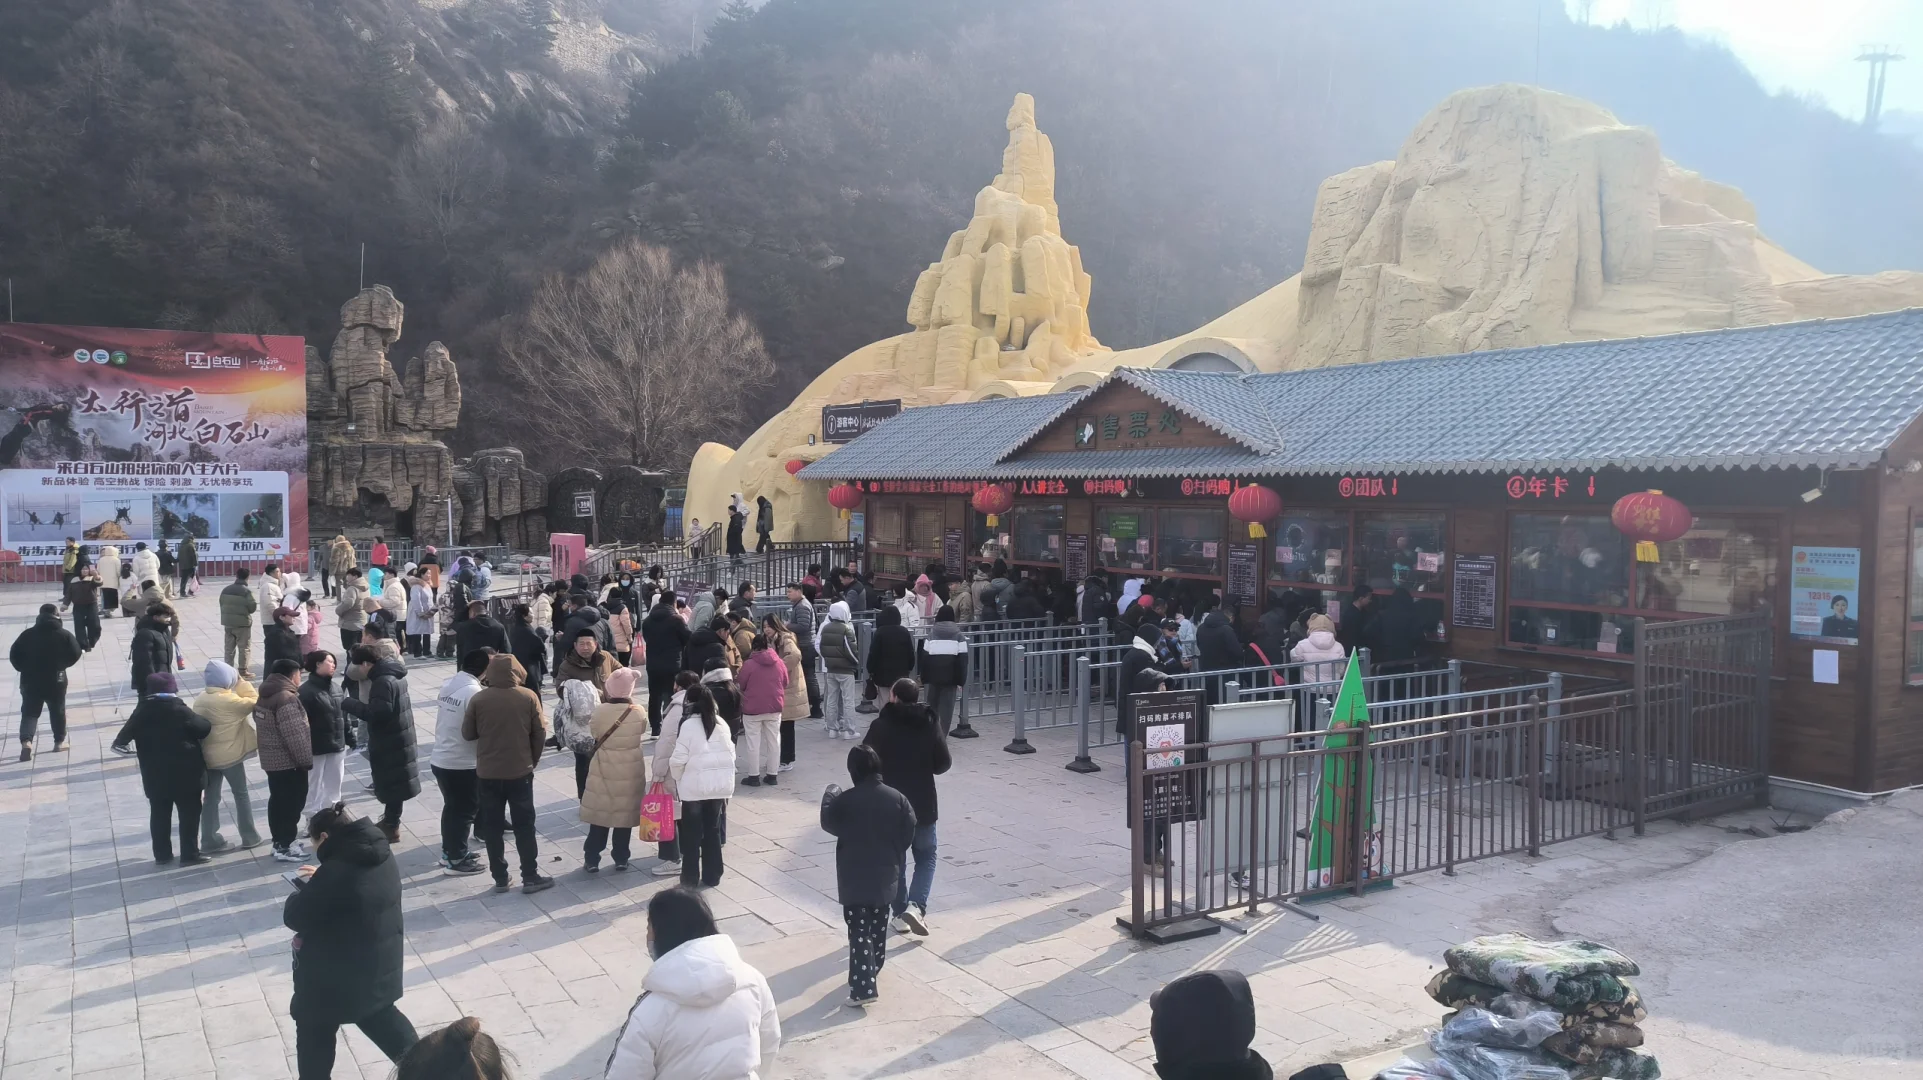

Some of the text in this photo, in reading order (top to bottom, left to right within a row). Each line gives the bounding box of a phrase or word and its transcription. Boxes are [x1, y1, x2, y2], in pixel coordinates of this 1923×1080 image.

[212, 356, 241, 366] 白石山
[80, 387, 196, 431] 太行之首
[836, 416, 860, 428] 游客中心
[1101, 409, 1182, 440] 售票处
[144, 418, 270, 450] 河北白石山
[57, 462, 240, 475] 来白石山拍出你的人生大片
[41, 477, 253, 486] 新品体验 高空挑战 惊险 刺激 无忧畅享玩
[229, 541, 264, 551] 飞拉达
[1808, 591, 1832, 601] 12315
[1139, 711, 1192, 723] 扫码购票不排队
